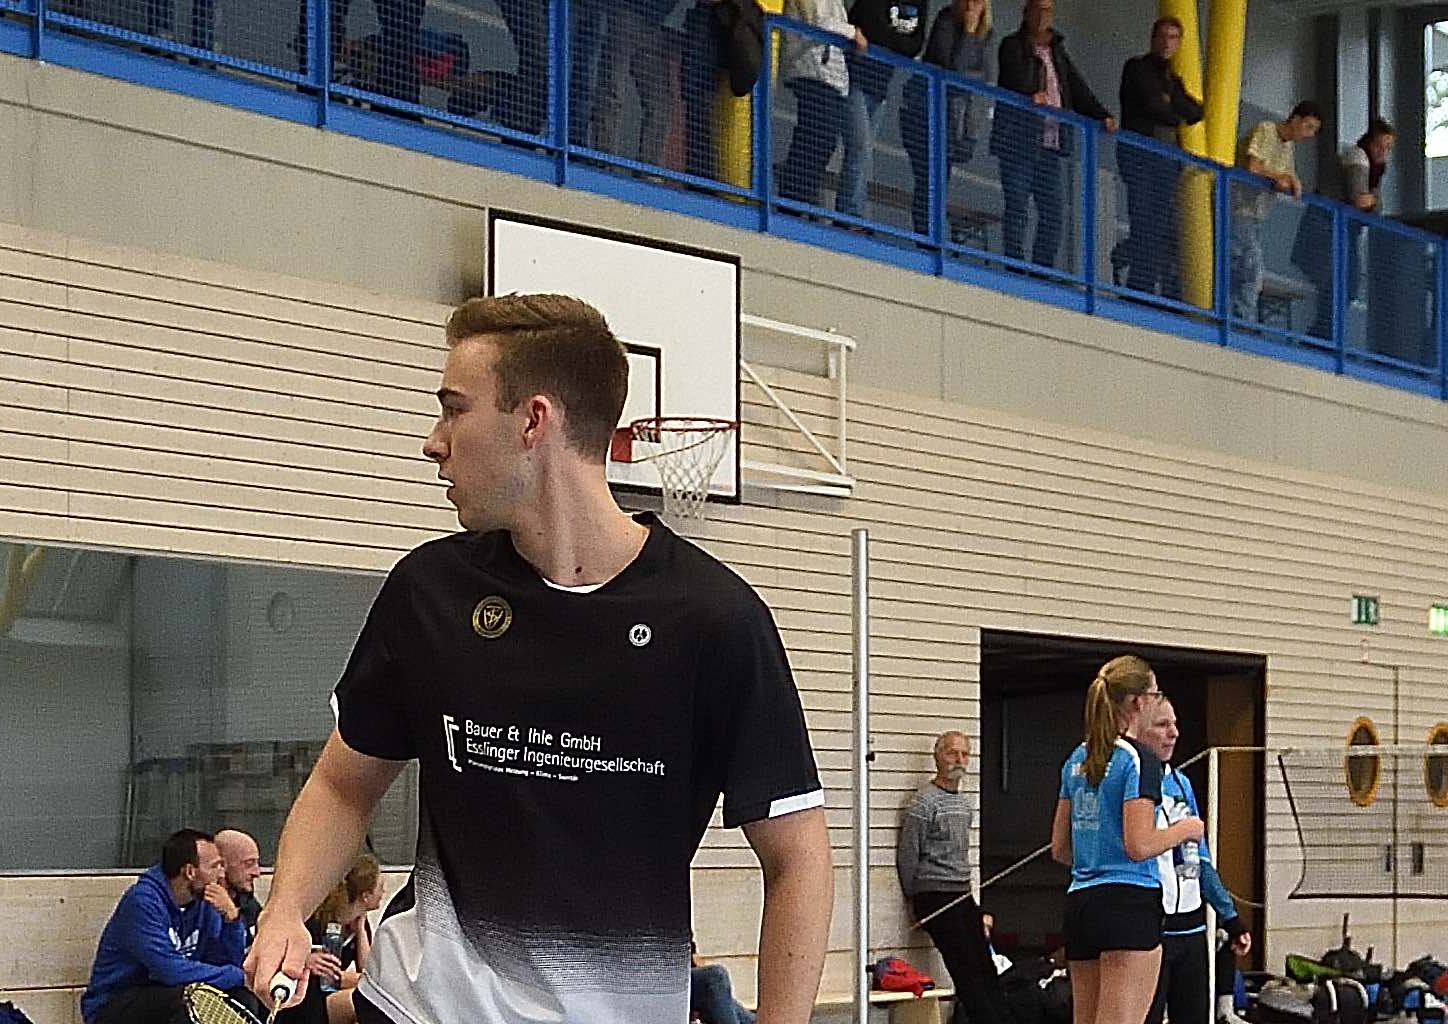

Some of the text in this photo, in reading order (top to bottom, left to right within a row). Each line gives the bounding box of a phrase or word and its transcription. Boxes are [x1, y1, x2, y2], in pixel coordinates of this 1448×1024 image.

[465, 719, 503, 739] Bauer
[528, 727, 553, 746] Ihle
[560, 732, 601, 752] GmbH
[466, 738, 520, 763] Esslinger
[523, 747, 665, 776] Ingenieurgesellschaft
